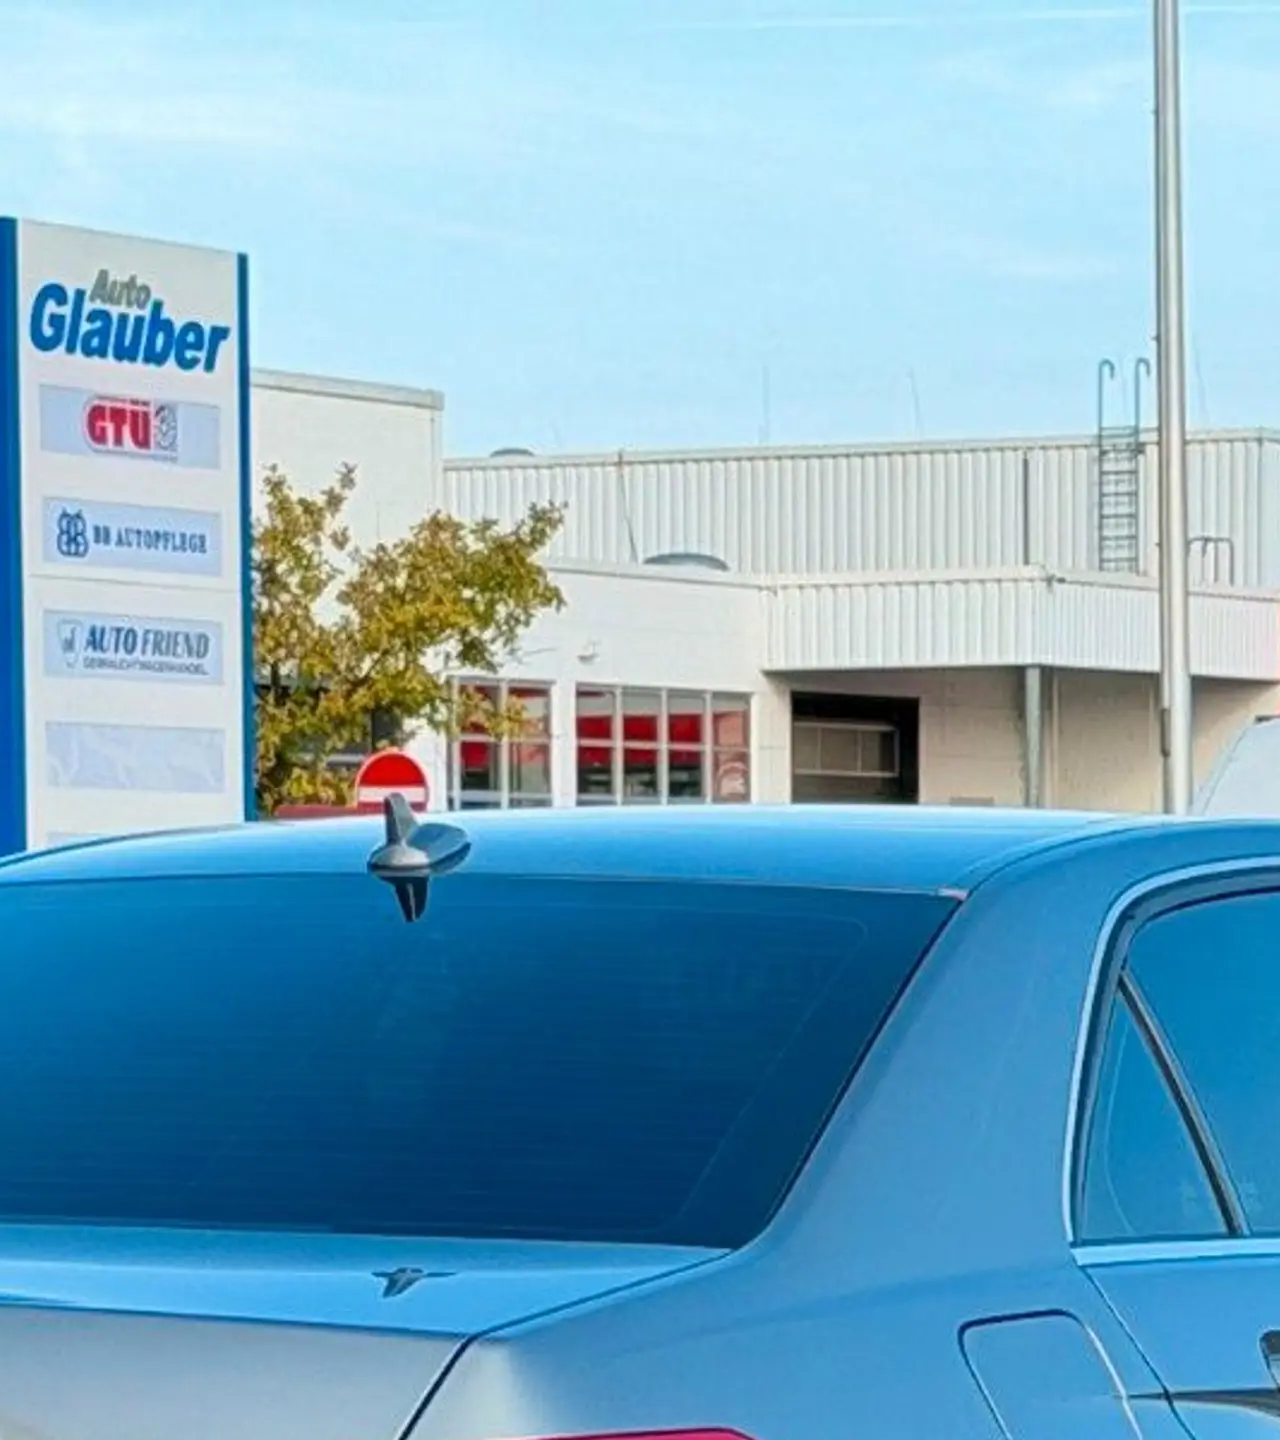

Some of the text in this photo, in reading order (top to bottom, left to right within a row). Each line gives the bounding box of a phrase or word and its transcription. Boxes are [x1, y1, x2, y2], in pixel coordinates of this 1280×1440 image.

[90, 269, 151, 310] Auto
[29, 283, 230, 373] Glauber
[86, 399, 152, 450] GTÜ
[115, 528, 207, 554] AUTOPFLEGE
[84, 624, 210, 659] AUTO FRIEND
